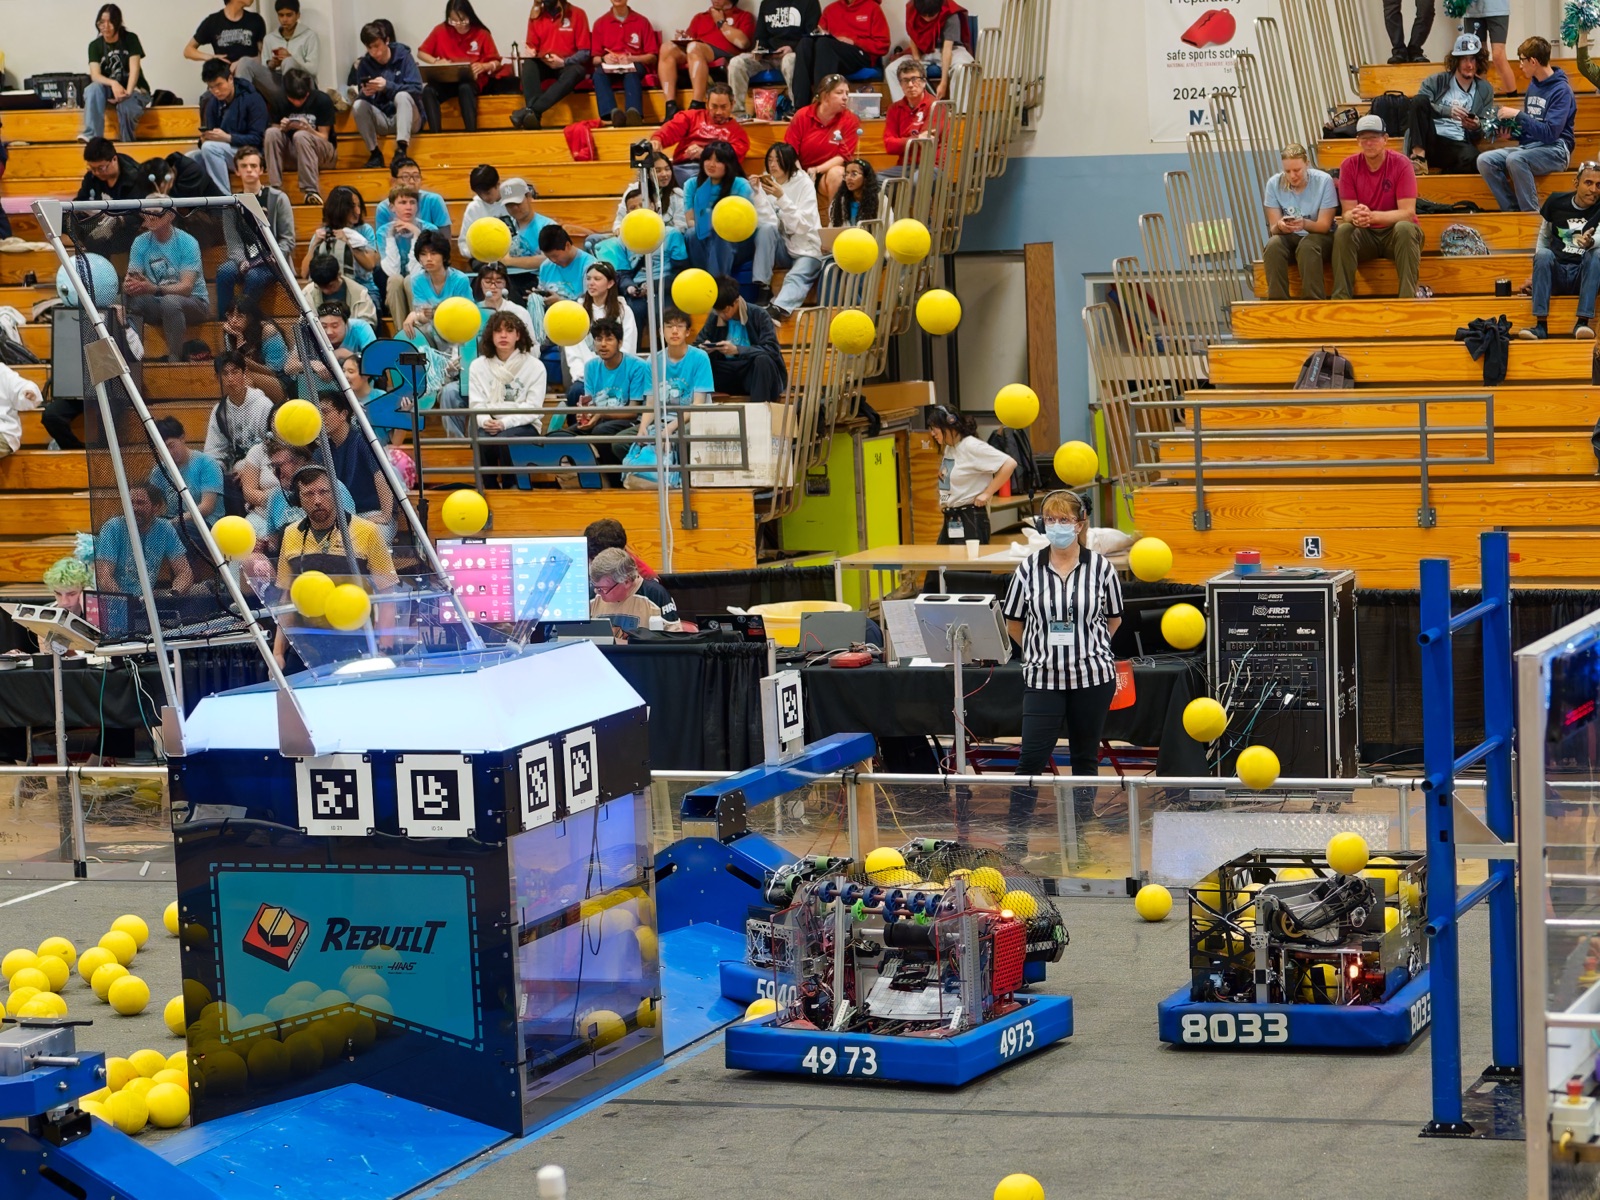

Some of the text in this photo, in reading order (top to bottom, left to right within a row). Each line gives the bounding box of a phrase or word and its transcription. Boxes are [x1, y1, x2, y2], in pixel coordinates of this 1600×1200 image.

[765, 14, 789, 22] NORTH
[771, 20, 789, 28] FACE
[1167, 50, 1186, 60] safe
[1189, 49, 1217, 62] sports
[320, 917, 447, 954] REBUILT
[388, 962, 417, 971] HAAS
[1181, 1013, 1288, 1044] 8033
[1000, 1020, 1034, 1058] 4973
